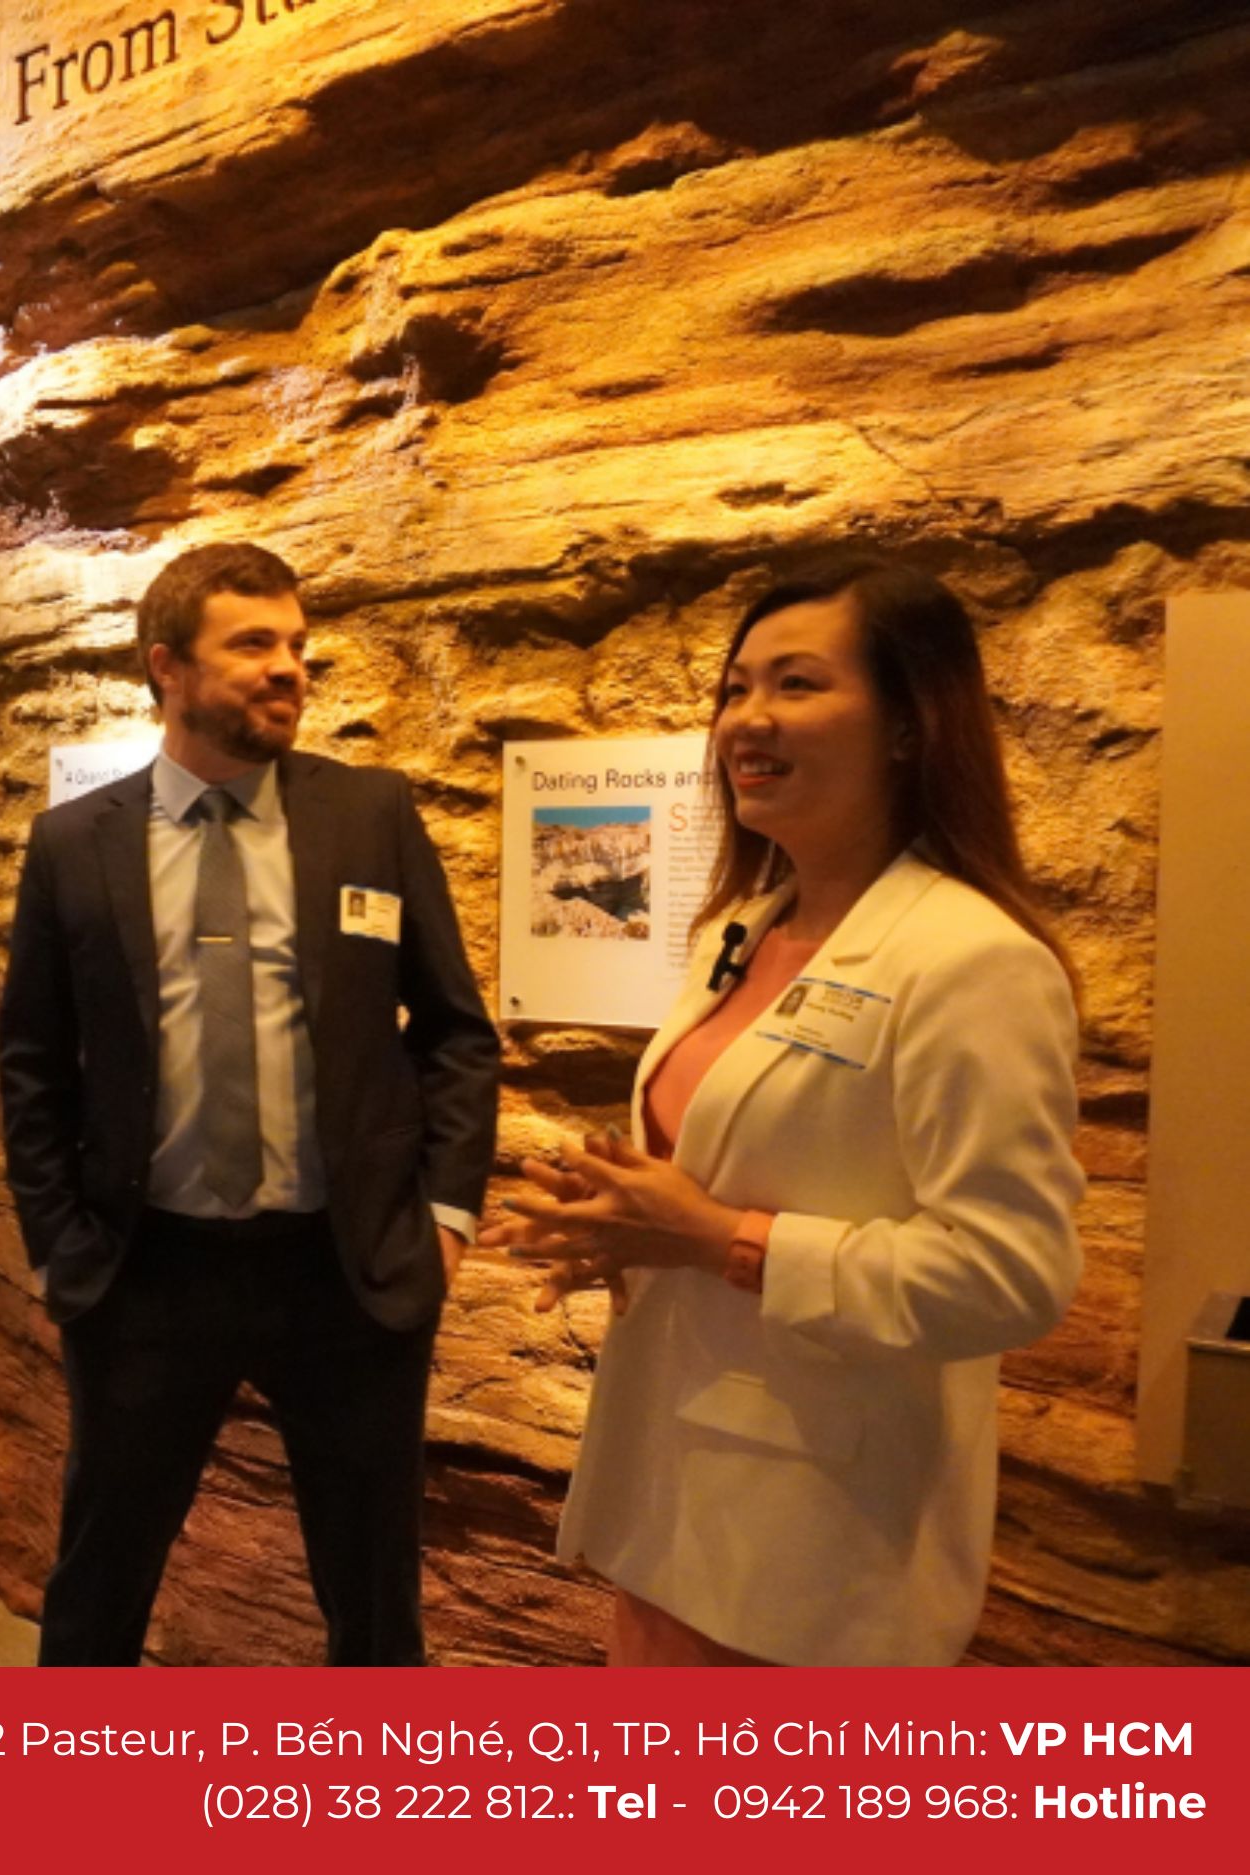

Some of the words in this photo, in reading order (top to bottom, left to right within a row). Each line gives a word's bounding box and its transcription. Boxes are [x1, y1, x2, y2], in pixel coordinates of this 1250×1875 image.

[14, 9, 180, 126] From
[534, 771, 598, 794] Dating
[606, 769, 667, 789] Rocks
